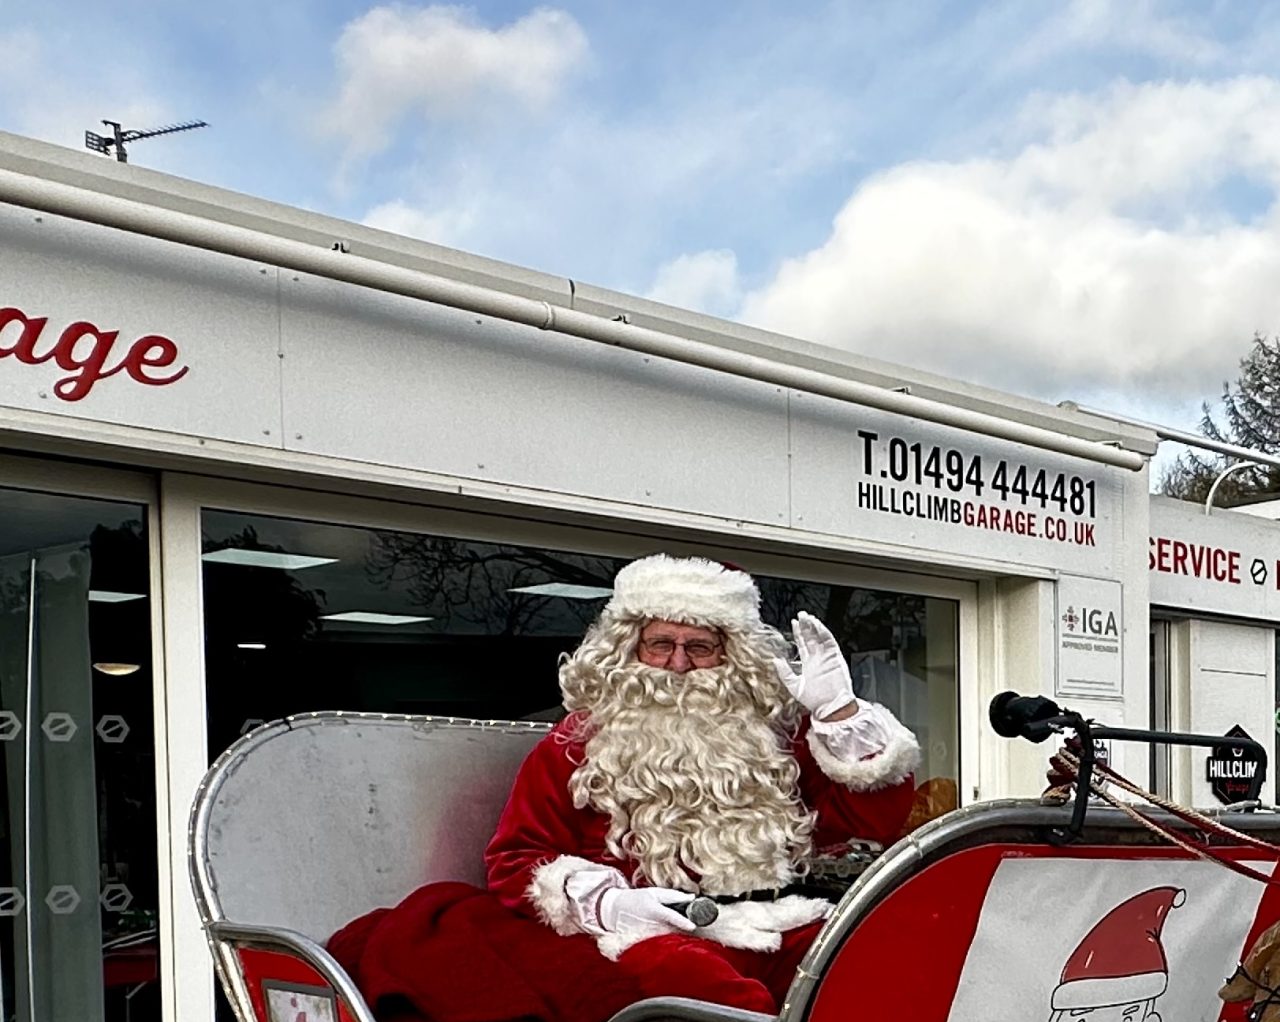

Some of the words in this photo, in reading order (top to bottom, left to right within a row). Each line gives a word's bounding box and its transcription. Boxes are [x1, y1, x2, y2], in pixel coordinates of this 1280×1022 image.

[857, 430, 985, 497] T.01494
[991, 460, 1096, 519] 444481
[858, 481, 1096, 547] HILLCLIMBGARAGE.CO.UK
[1082, 607, 1119, 637] IGA
